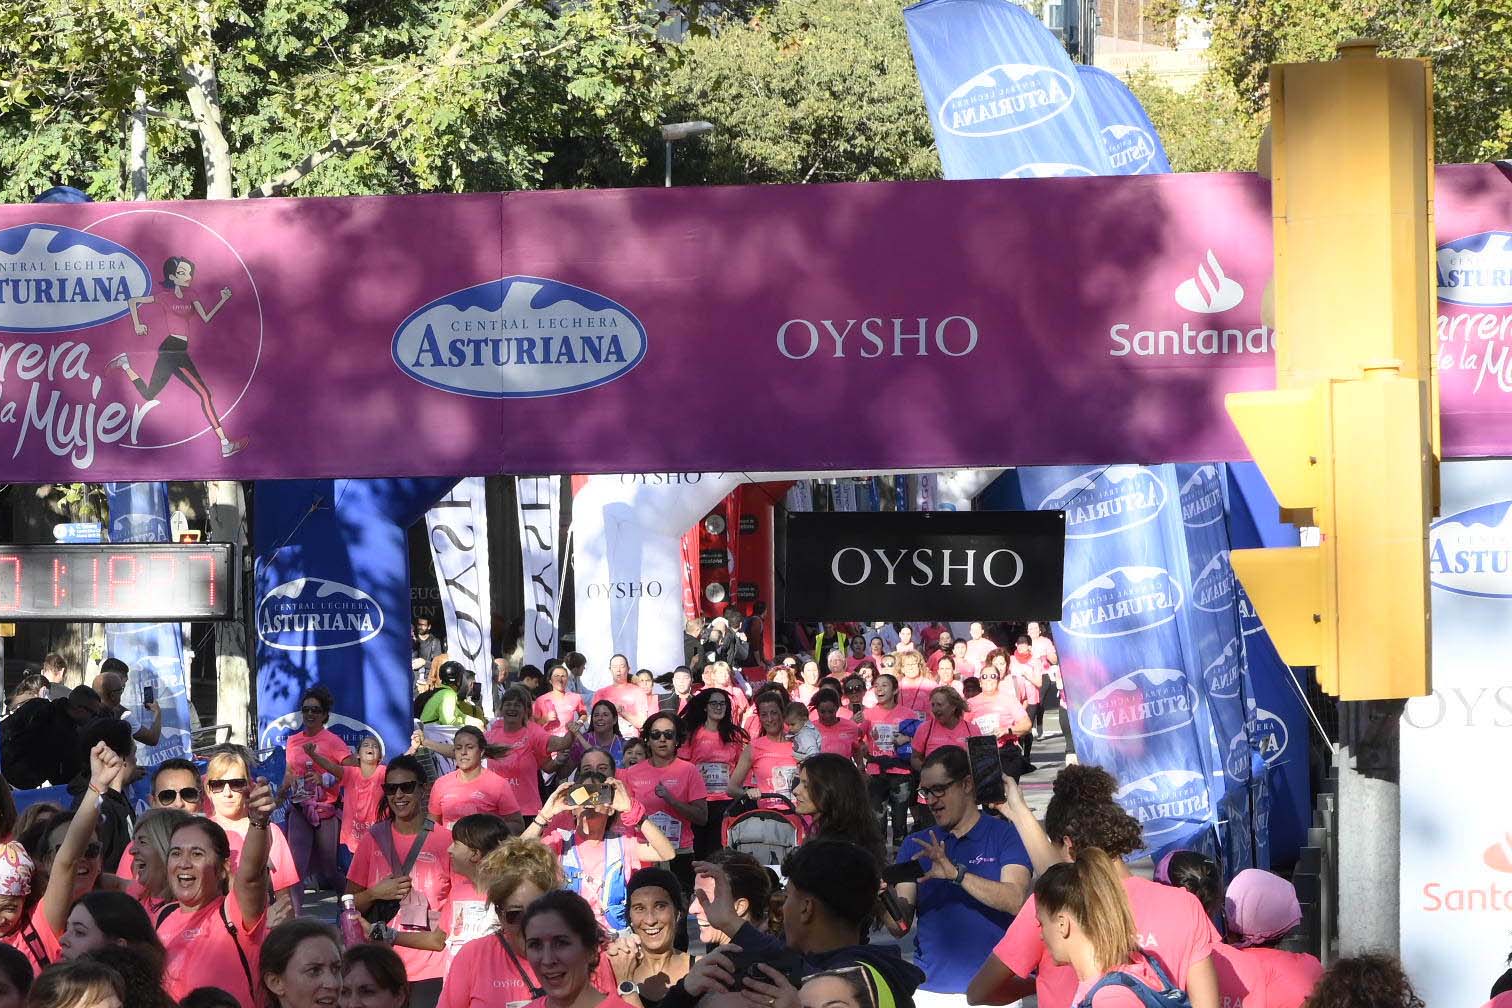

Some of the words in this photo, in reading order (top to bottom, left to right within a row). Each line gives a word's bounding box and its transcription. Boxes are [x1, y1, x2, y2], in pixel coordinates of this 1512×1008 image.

[54, 260, 127, 272] LECHERA
[450, 320, 533, 332] CENTRAL
[538, 317, 619, 330] LECHERA
[776, 316, 979, 360] OYSHO
[411, 323, 627, 368] ASTURIANA
[13, 375, 161, 469] Mujer
[831, 547, 1025, 588] OYSHO
[588, 580, 662, 599] OYSHO
[261, 609, 374, 634] ASTURIANA
